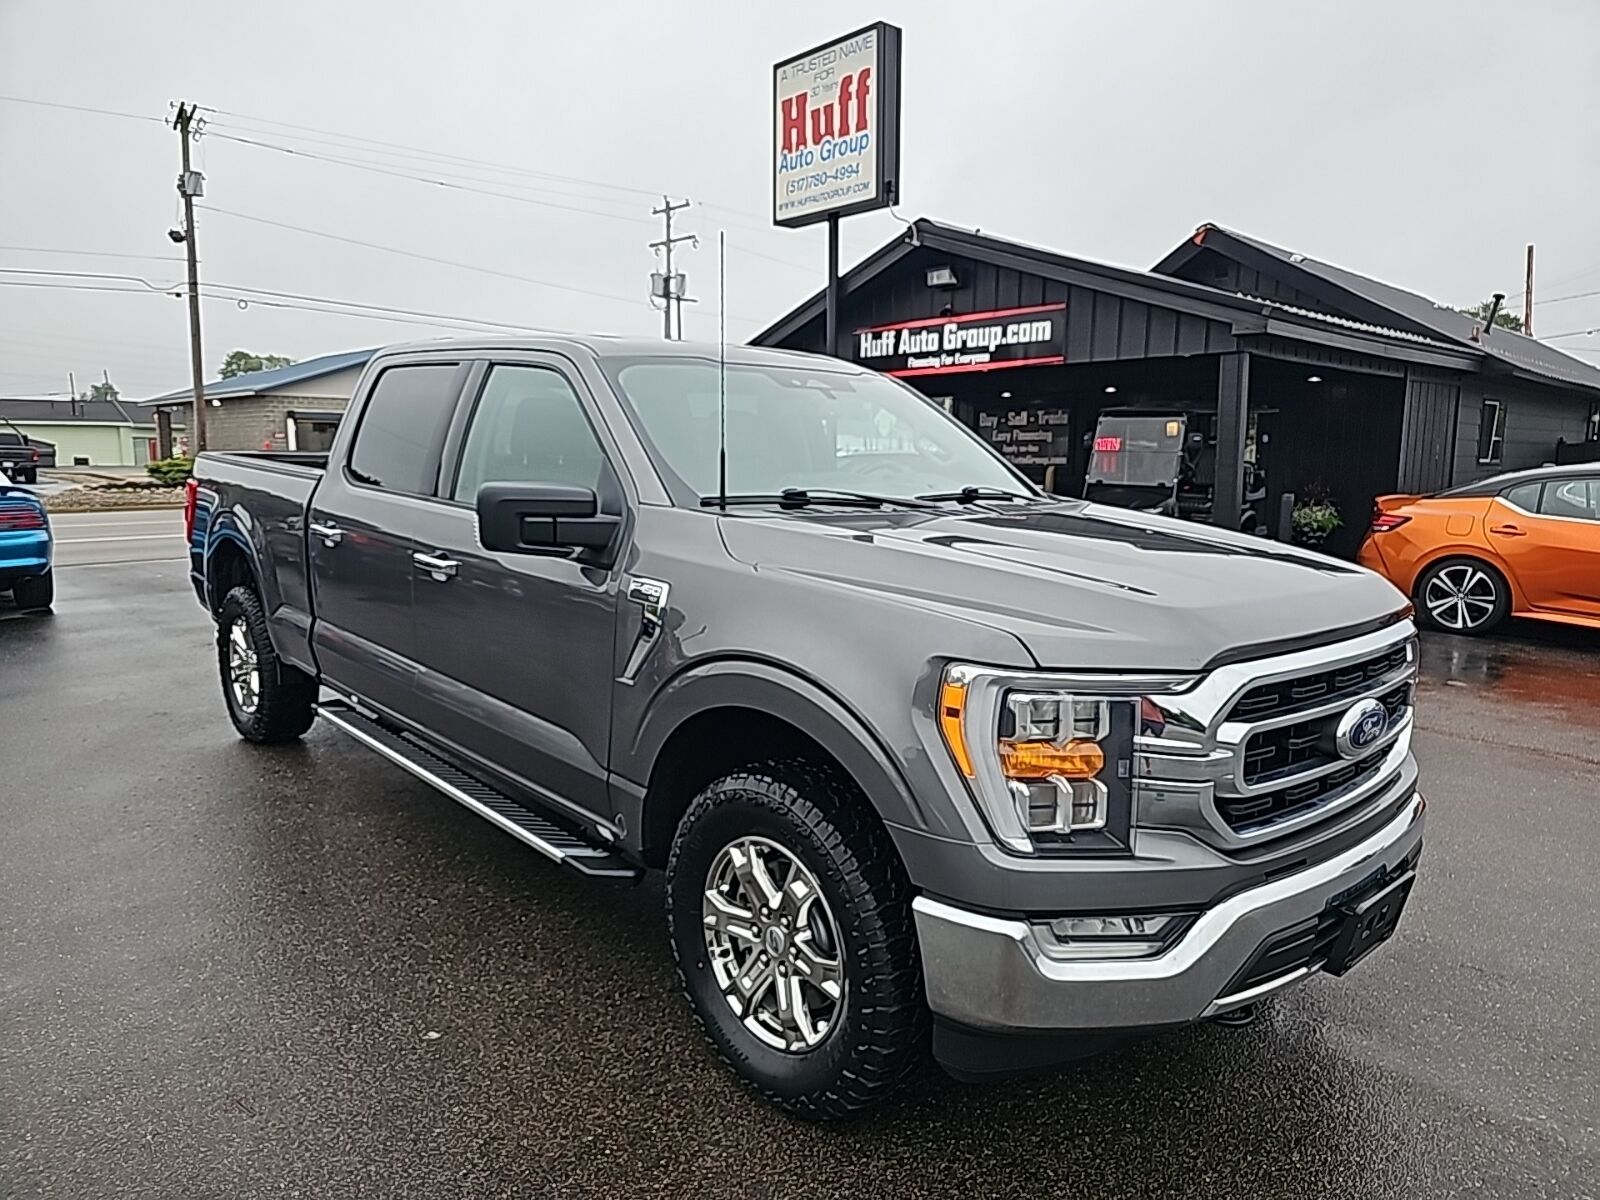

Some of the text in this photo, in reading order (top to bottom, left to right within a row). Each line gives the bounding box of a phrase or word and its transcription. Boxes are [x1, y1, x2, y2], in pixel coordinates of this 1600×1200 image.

[791, 50, 837, 78] TRUSTED
[839, 34, 873, 59] NAME
[813, 67, 835, 82] FOR
[781, 67, 871, 154] Huff
[779, 133, 869, 175] Auto Group
[786, 162, 860, 196] (517)780-4994
[859, 320, 1052, 358] Huff Auto Group.com
[907, 352, 990, 369] Financing For Everyone
[979, 412, 998, 429] Buy
[1007, 411, 1027, 426] Sell
[1037, 410, 1068, 425] Trade
